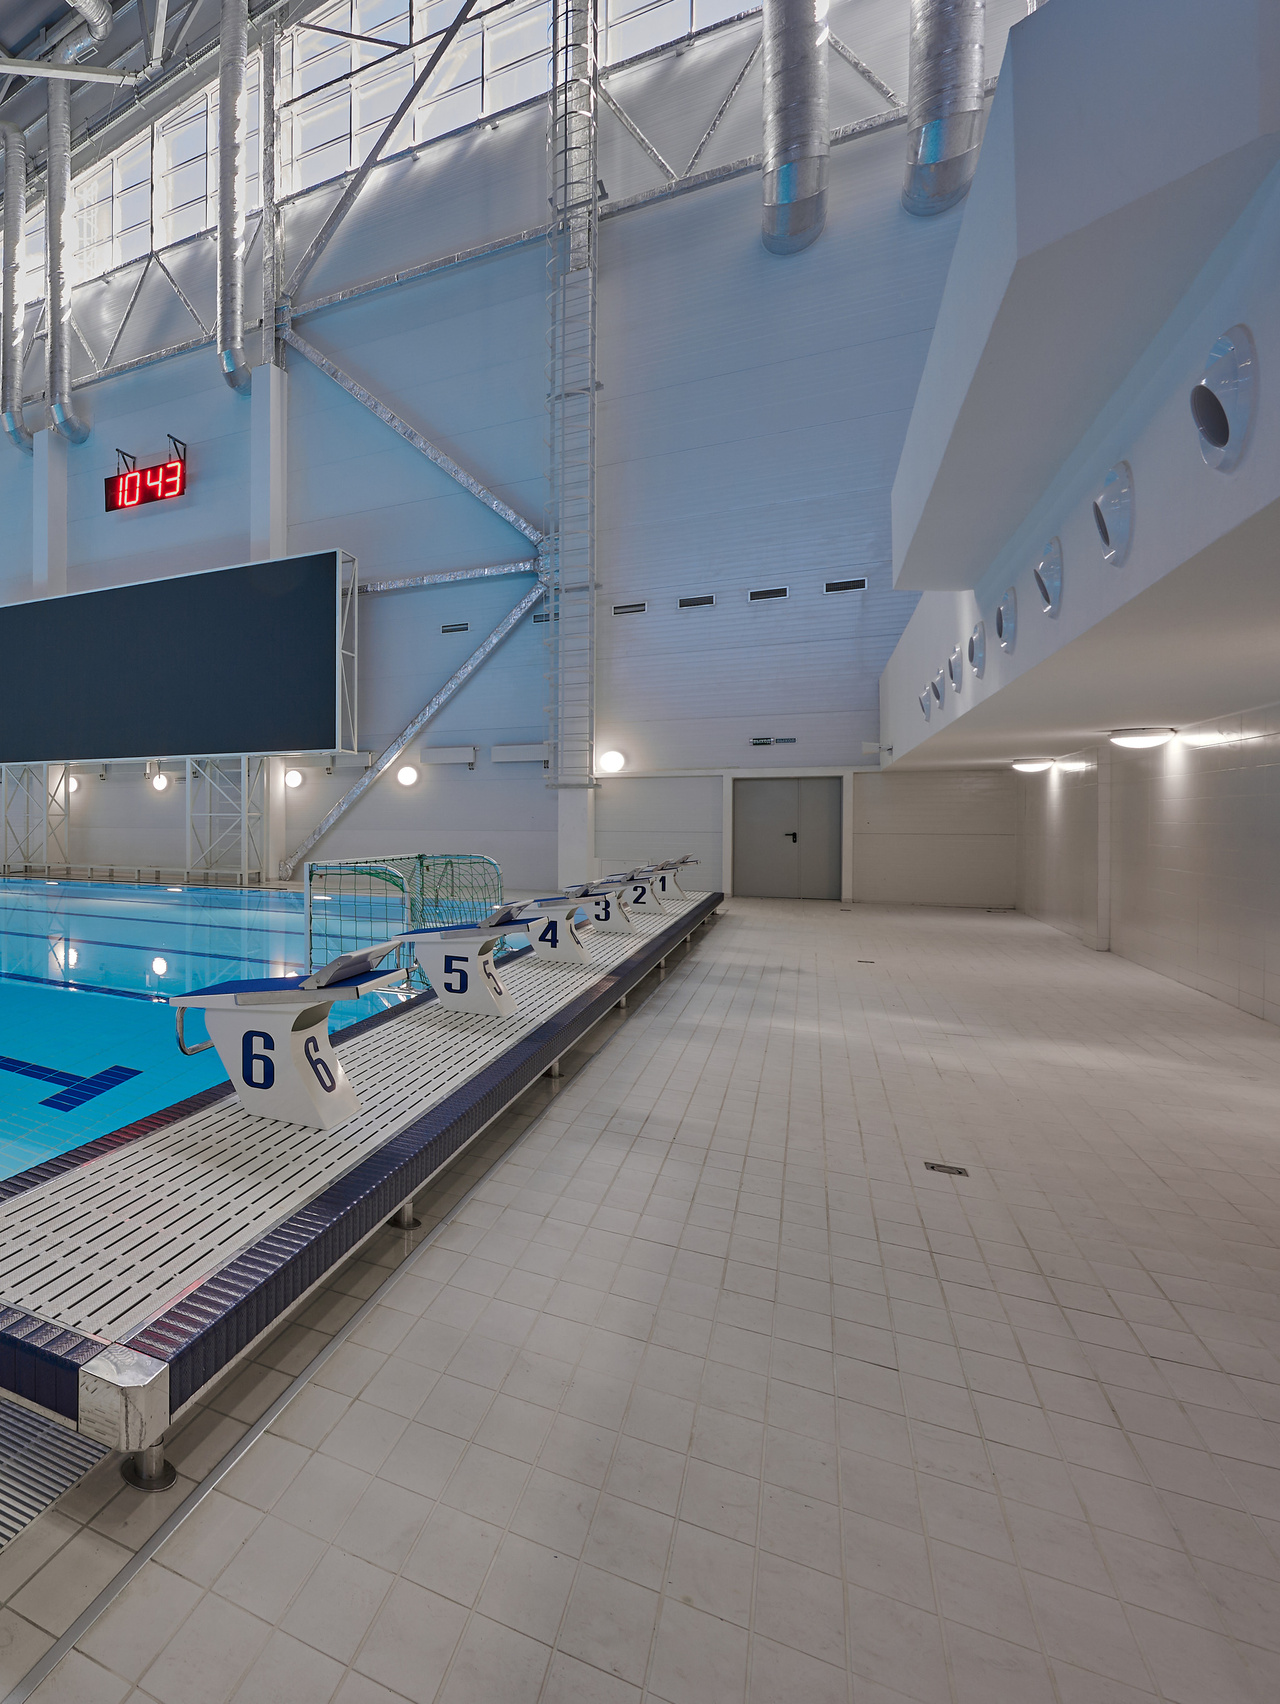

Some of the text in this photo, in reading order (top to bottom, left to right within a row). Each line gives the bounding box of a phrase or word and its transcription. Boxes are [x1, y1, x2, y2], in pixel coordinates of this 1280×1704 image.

[632, 885, 647, 905] 2
[659, 876, 666, 892] 1
[594, 900, 611, 921] 3
[538, 920, 559, 949] 4
[443, 954, 469, 994] 5
[482, 959, 503, 996] 5
[242, 1029, 275, 1090] 6
[304, 1035, 336, 1093] 6
